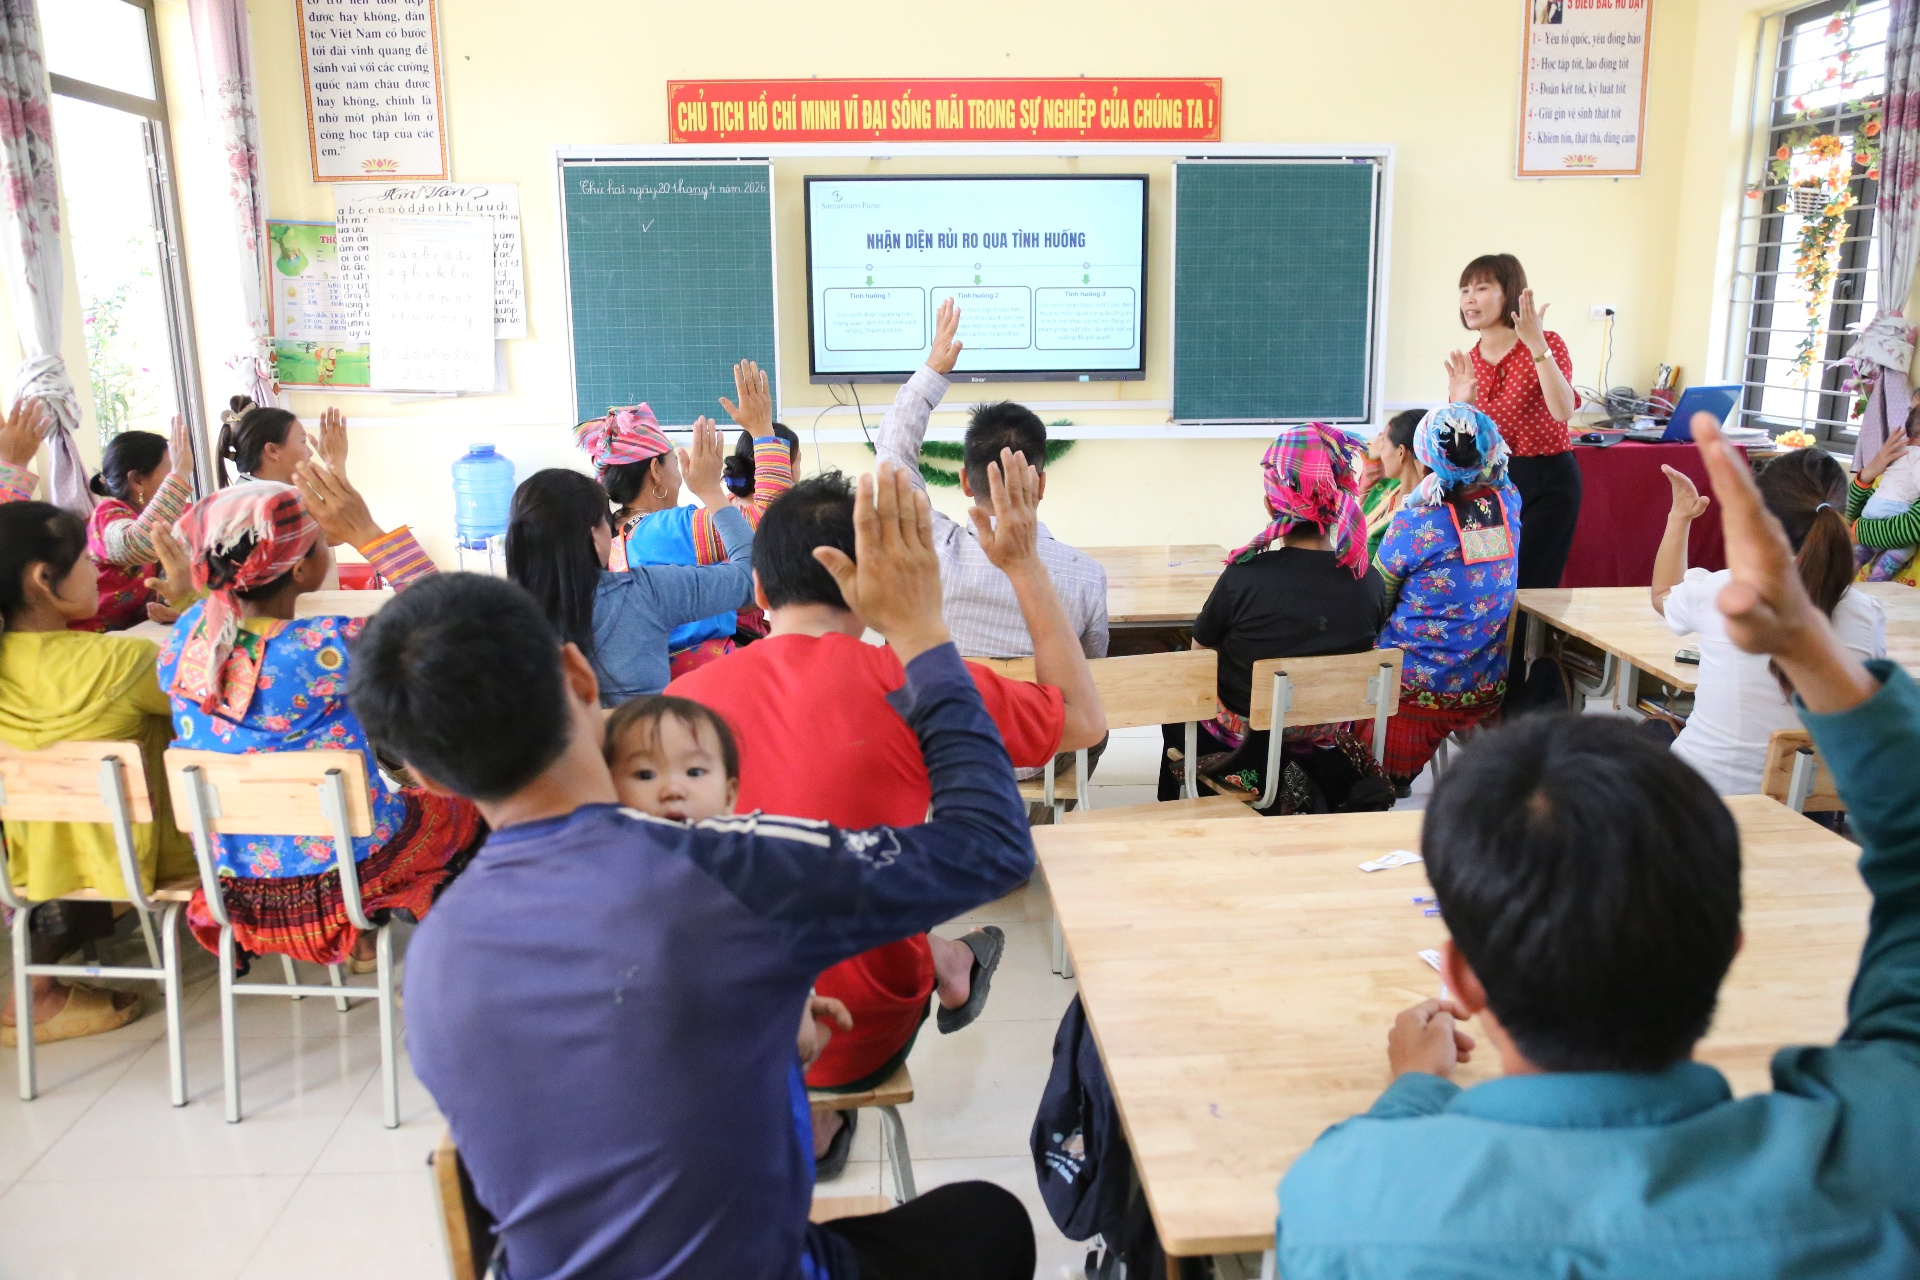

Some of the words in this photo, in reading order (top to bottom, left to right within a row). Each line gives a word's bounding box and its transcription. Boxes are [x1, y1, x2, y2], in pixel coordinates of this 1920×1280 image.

[340, 12, 358, 24] hay
[330, 29, 352, 41] Việt
[356, 28, 382, 38] Nam
[385, 28, 398, 38] có
[351, 46, 374, 55] vinh
[378, 46, 412, 58] quang
[313, 63, 338, 73] sánh
[341, 63, 357, 72] vai
[360, 63, 375, 72] với
[378, 62, 395, 72] các
[1586, 57, 1597, 70] lao
[317, 97, 336, 109] hay
[385, 95, 415, 105] chính
[422, 95, 432, 105] là
[677, 89, 708, 132] CHỦ
[711, 101, 745, 138] TỊCH
[748, 91, 768, 131] HỒ
[772, 94, 797, 131] CHÍ
[801, 101, 841, 131] MINH
[844, 94, 859, 130] VĨ
[862, 99, 887, 136] ĐẠI
[891, 89, 931, 130] SỐNG
[935, 94, 964, 129] MÃI
[968, 99, 1016, 129] TRONG
[1020, 96, 1041, 135] SỰ
[1044, 93, 1096, 135] NGHIỆP
[1101, 86, 1130, 129] CỦA
[1133, 93, 1182, 129] CHÚNG
[1186, 99, 1204, 129] TA
[1577, 106, 1593, 119] sinh
[349, 130, 368, 141] học
[417, 129, 435, 138] các
[607, 179, 626, 194] hai
[628, 184, 658, 201] ngày
[658, 182, 670, 194] 20
[672, 179, 709, 201] tháng
[709, 182, 716, 192] 4
[744, 181, 766, 193] 2026
[862, 201, 881, 209] Purse
[867, 229, 901, 252] NHẬN
[906, 229, 933, 252] DIỆN
[938, 227, 958, 249] RỦI
[963, 232, 979, 249] RO
[983, 232, 1008, 250] QUA
[1012, 229, 1040, 249] TÌNH
[1044, 227, 1086, 249] HUỐNG
